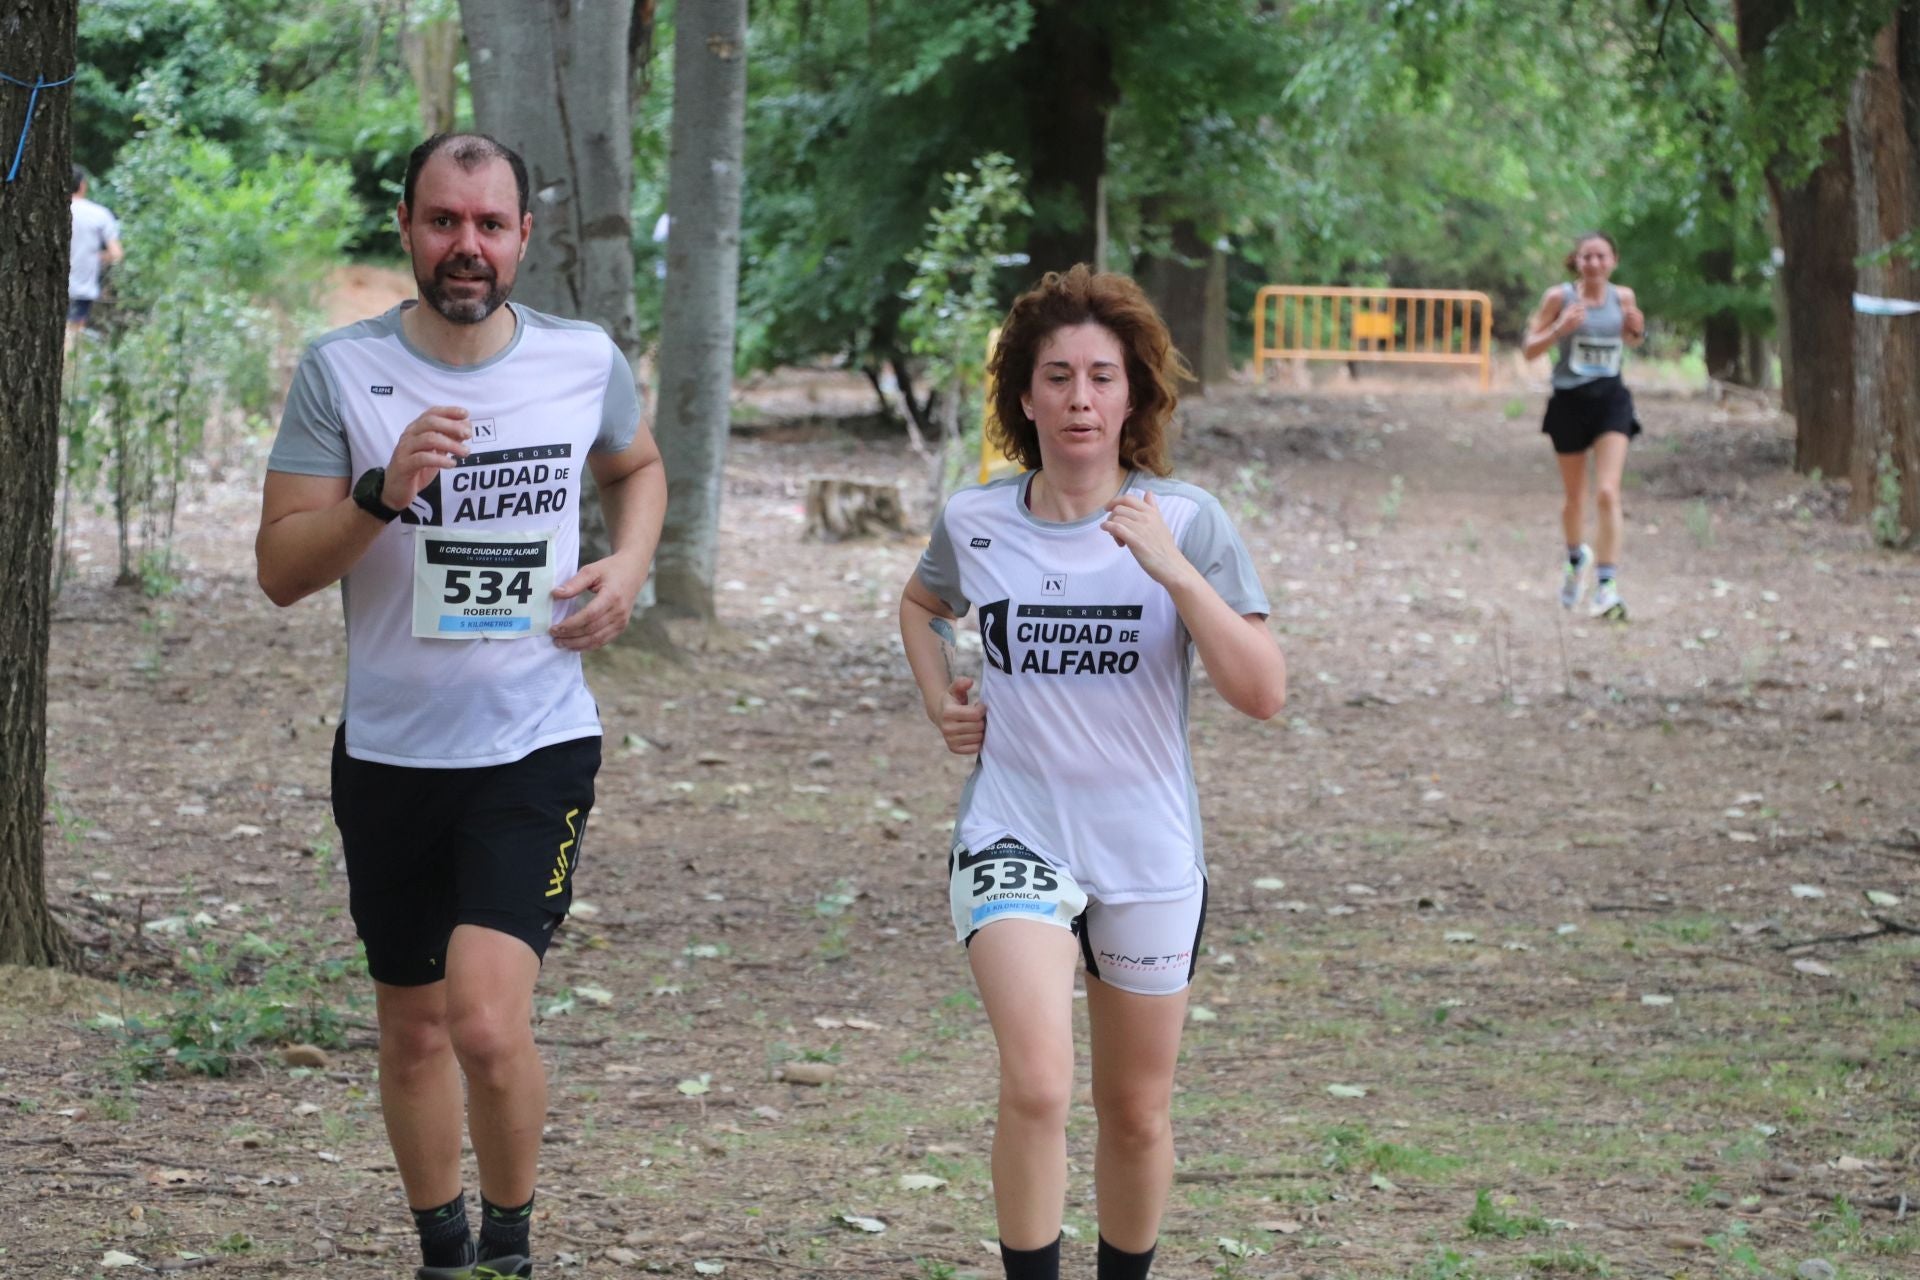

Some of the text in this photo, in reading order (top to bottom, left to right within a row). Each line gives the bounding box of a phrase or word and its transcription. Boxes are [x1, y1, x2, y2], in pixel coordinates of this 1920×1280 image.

[475, 425, 491, 437] IN
[461, 448, 566, 465] II CROSS
[452, 464, 570, 493] CIUDAD DE
[453, 488, 567, 523] ALFARO
[445, 547, 472, 555] CROSS
[472, 548, 502, 556] CIUDAD
[502, 548, 513, 556] DE
[514, 547, 539, 556] ALFARO
[443, 569, 533, 605] 534
[1045, 579, 1062, 591] IN
[463, 608, 513, 616] ROBERTO
[1026, 608, 1133, 617] II CROSS
[1016, 622, 1140, 644] CIUDAD DE
[1020, 649, 1140, 675] ALFARO
[996, 842, 1026, 851] CIUDAD
[972, 861, 1059, 897] 535
